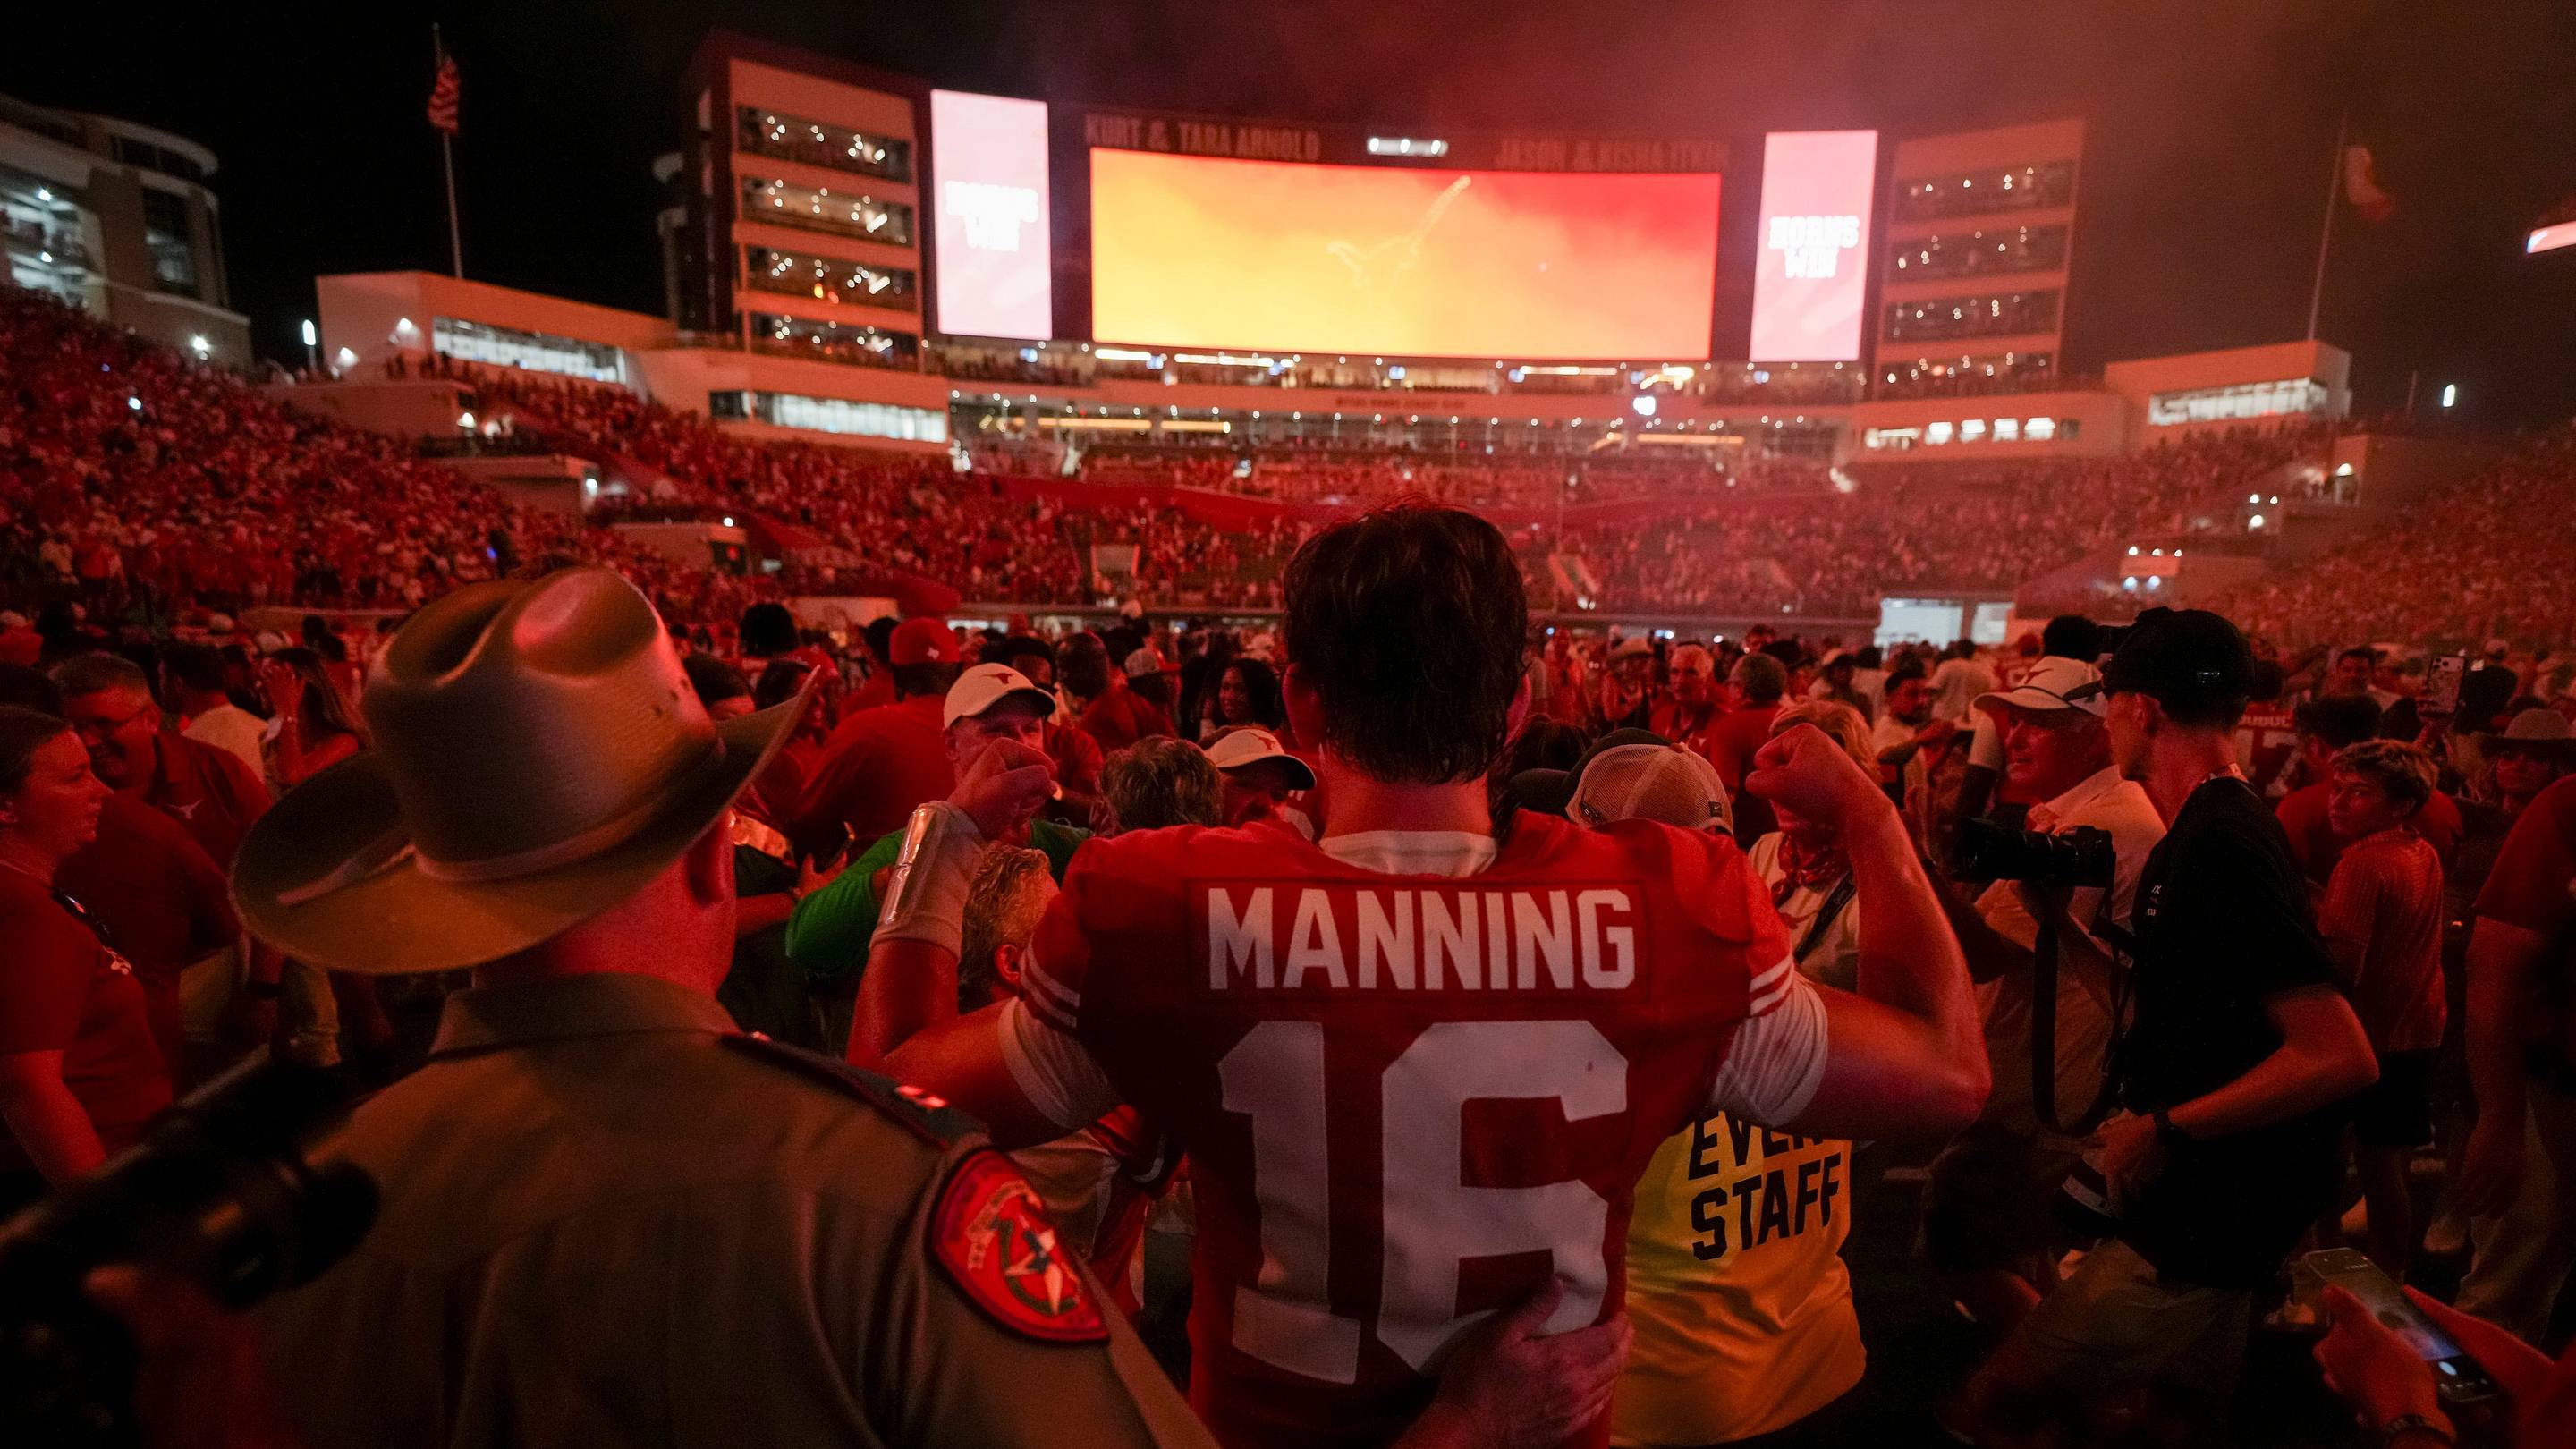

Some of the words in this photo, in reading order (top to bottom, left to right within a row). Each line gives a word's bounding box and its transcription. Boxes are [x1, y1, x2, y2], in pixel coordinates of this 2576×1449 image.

[1084, 114, 1140, 148] KURT
[1178, 122, 1232, 155] TARA
[1235, 126, 1320, 161] ARNOLD
[1208, 887, 1636, 991] MANNING
[1216, 1020, 1629, 1385] 16
[1690, 1151, 1842, 1261] STAFF
